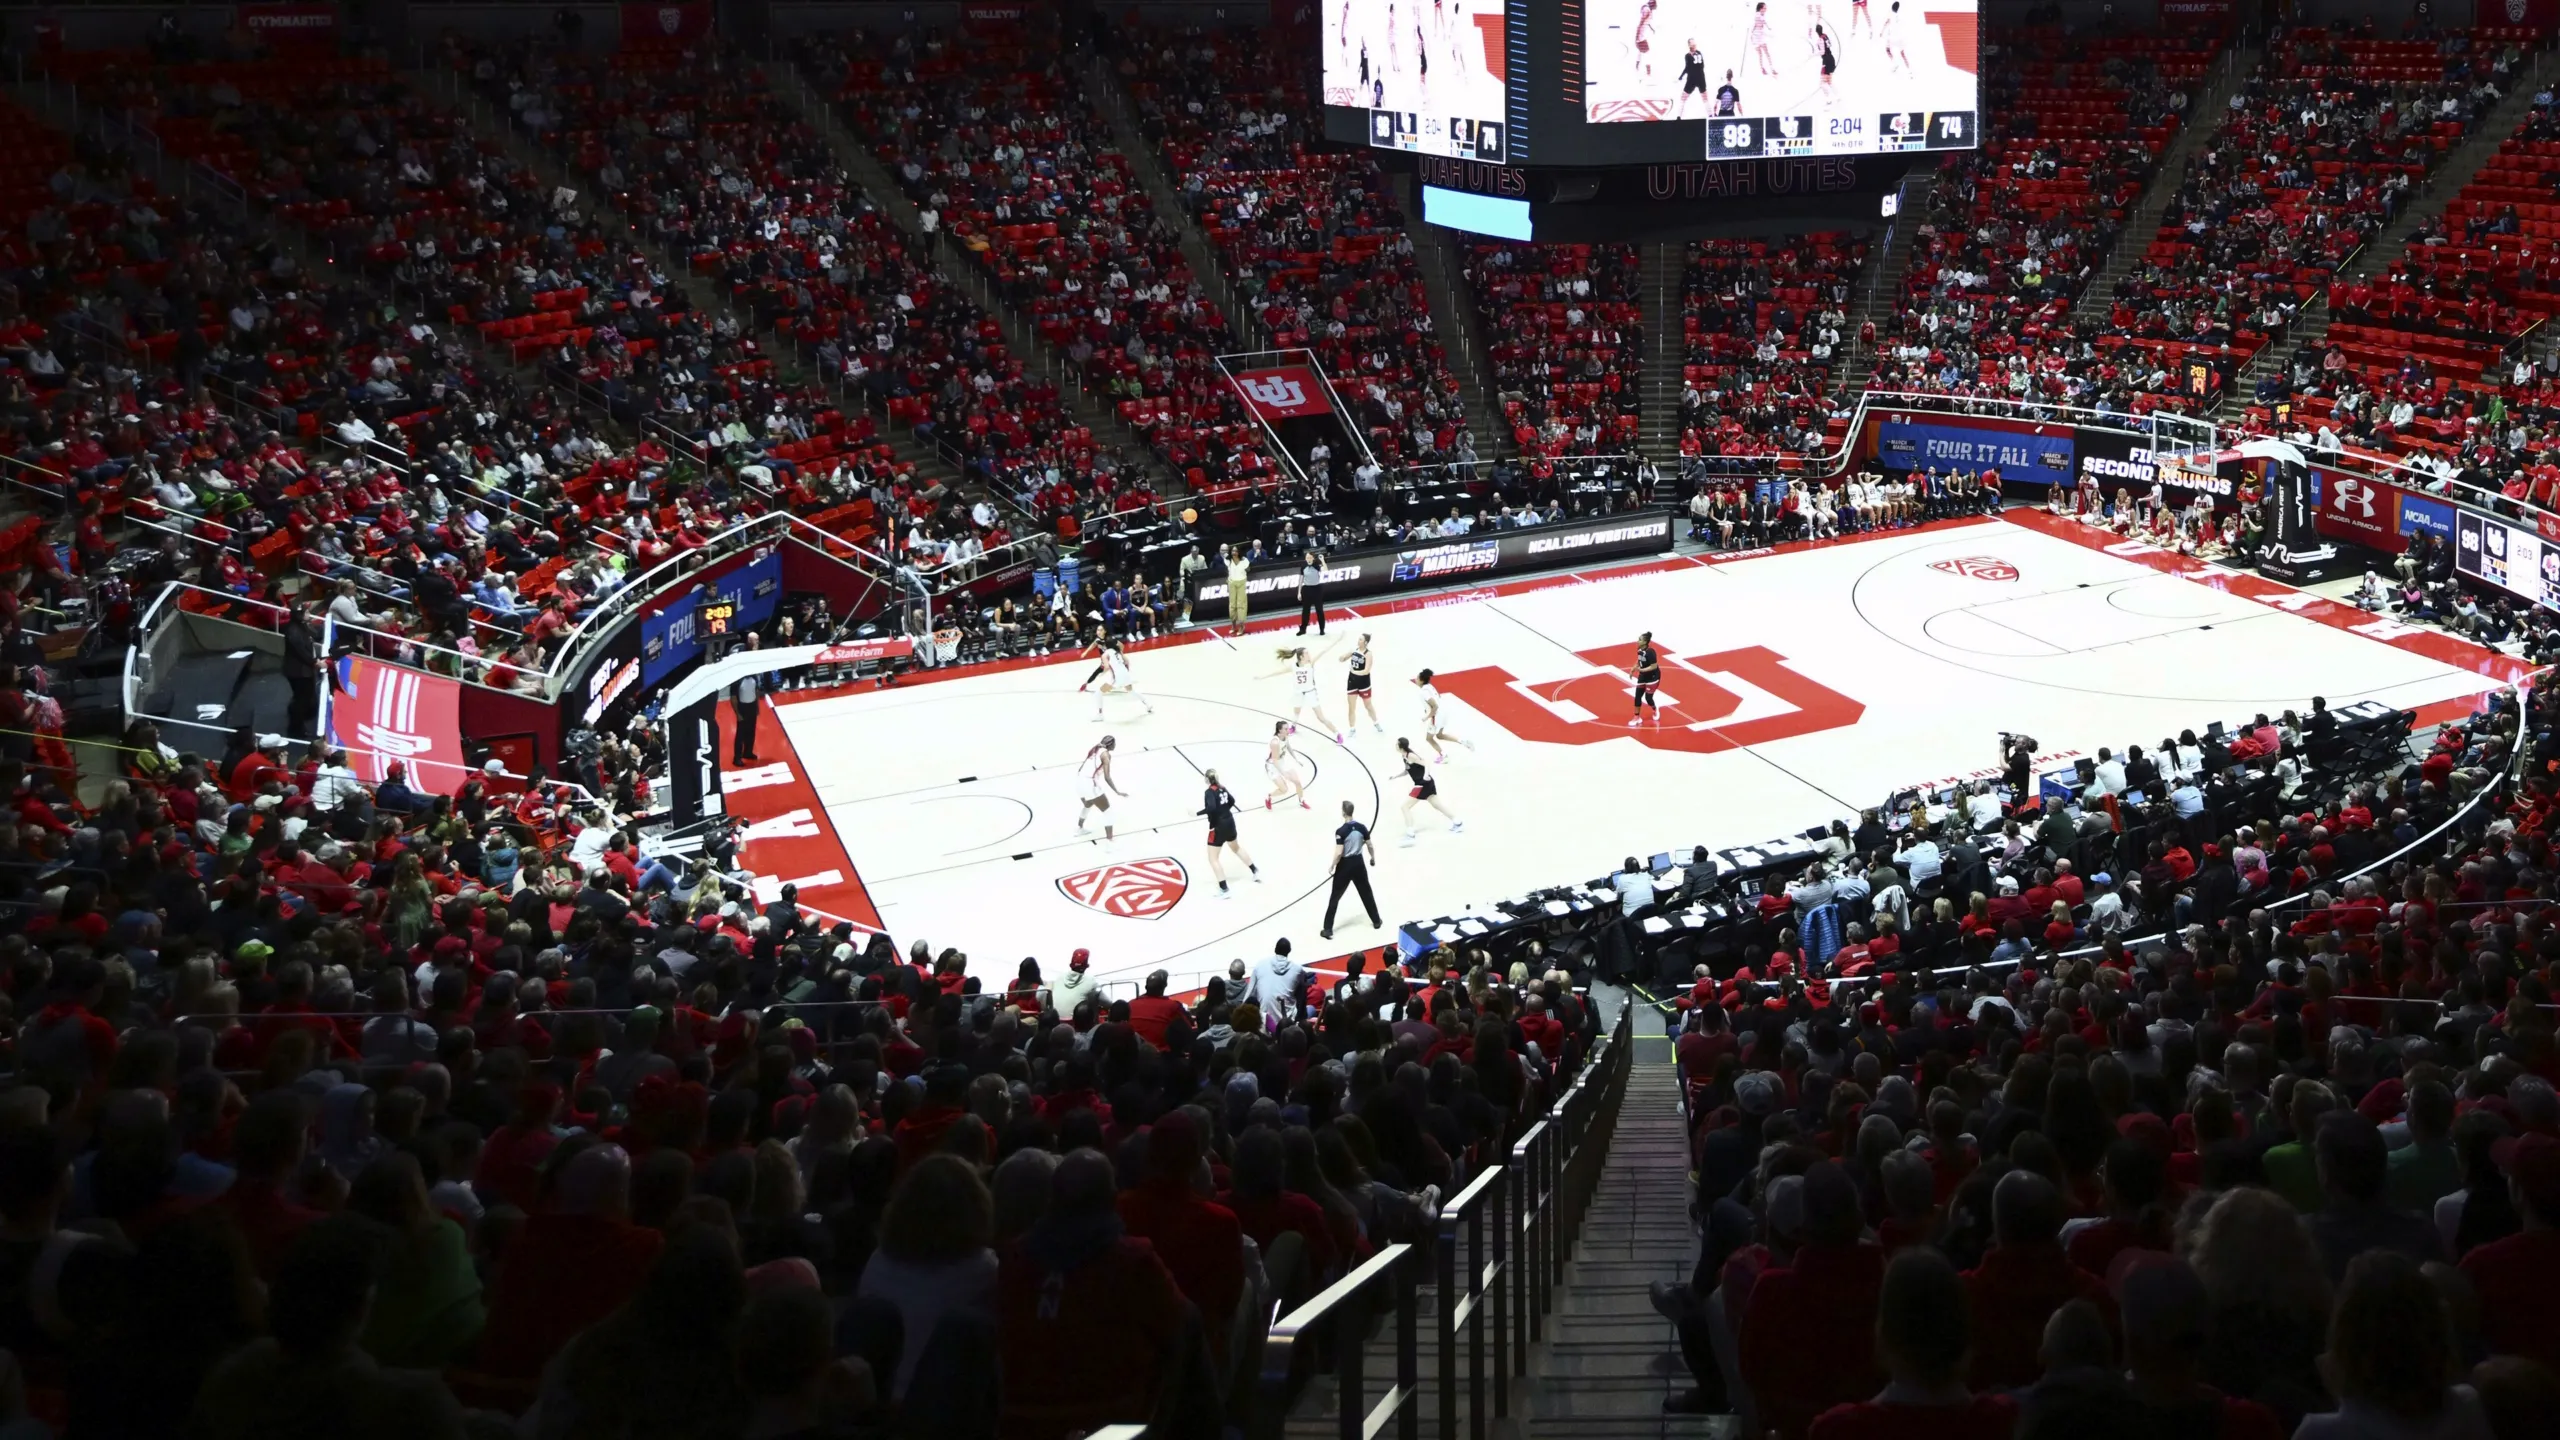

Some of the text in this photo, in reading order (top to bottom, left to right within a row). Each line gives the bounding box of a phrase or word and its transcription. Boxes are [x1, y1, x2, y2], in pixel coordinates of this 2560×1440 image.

[1723, 124, 1751, 148] 98
[1830, 117, 1862, 135] 2:04
[1939, 116, 1962, 139] 74
[1419, 155, 1526, 196] UTAH UTES
[1648, 156, 1857, 200] UTAH UTES
[1926, 438, 2030, 468] FOUR IT ALL
[2083, 456, 2232, 496] SECOND ROUNDS
[2326, 512, 2382, 533] UNDER ARMOUR
[1422, 549, 1497, 572] MADNESS
[705, 605, 733, 620] 2:03
[669, 617, 696, 650] FOU
[711, 620, 726, 634] 19
